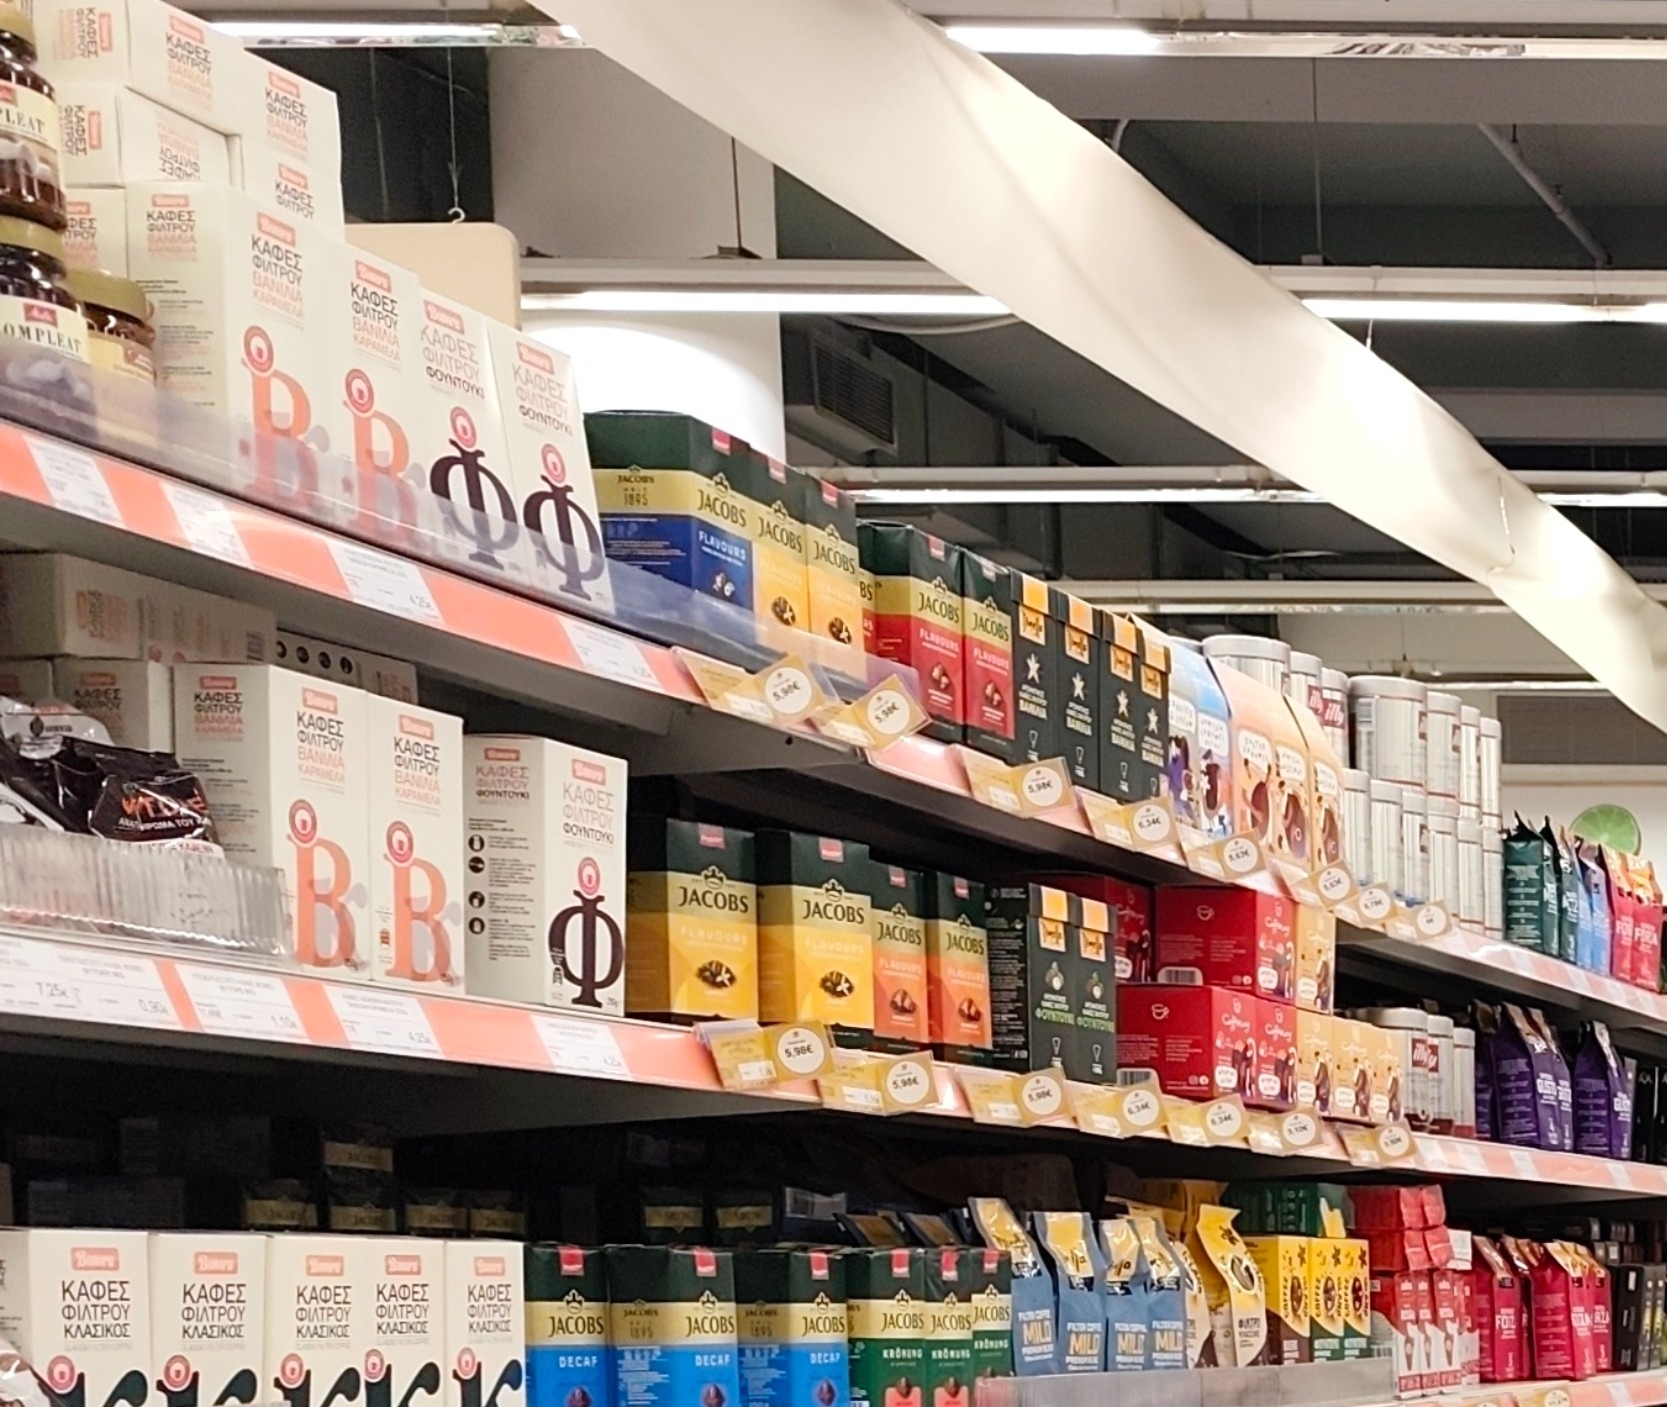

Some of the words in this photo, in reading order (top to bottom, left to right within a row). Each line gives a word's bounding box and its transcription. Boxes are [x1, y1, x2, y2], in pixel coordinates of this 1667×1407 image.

[0, 322, 82, 352] OMPLEAT
[697, 488, 746, 528] JACOBS
[918, 591, 960, 623] JACOBS
[678, 885, 748, 913] JACOBS
[802, 899, 864, 926] JACOBS
[783, 1043, 813, 1057] 5,98€
[61, 1280, 130, 1302] ΚΑΦΕΣ
[183, 1283, 247, 1303] ΚΑΦΕΣ
[468, 1284, 512, 1302] ΚΑΦΕΣ
[61, 1303, 130, 1321] ΦΙΛΤΡΟΥ
[181, 1306, 246, 1323] ΦΙΛΤΡΟΥ
[467, 1304, 512, 1319] ΦΙΛΤΡΟΥ
[881, 1310, 925, 1332] JACOBS
[973, 1303, 1011, 1324] JACOBS
[63, 1323, 130, 1339] ΚΛΑΣΙΚΟΣ
[182, 1324, 244, 1339] ΚΛΑΣΙΚΟΣ
[548, 1314, 604, 1336] JACOBS
[802, 1315, 846, 1336] JACOBS
[559, 1356, 597, 1367] DECAF
[810, 1353, 840, 1363] DECAF
